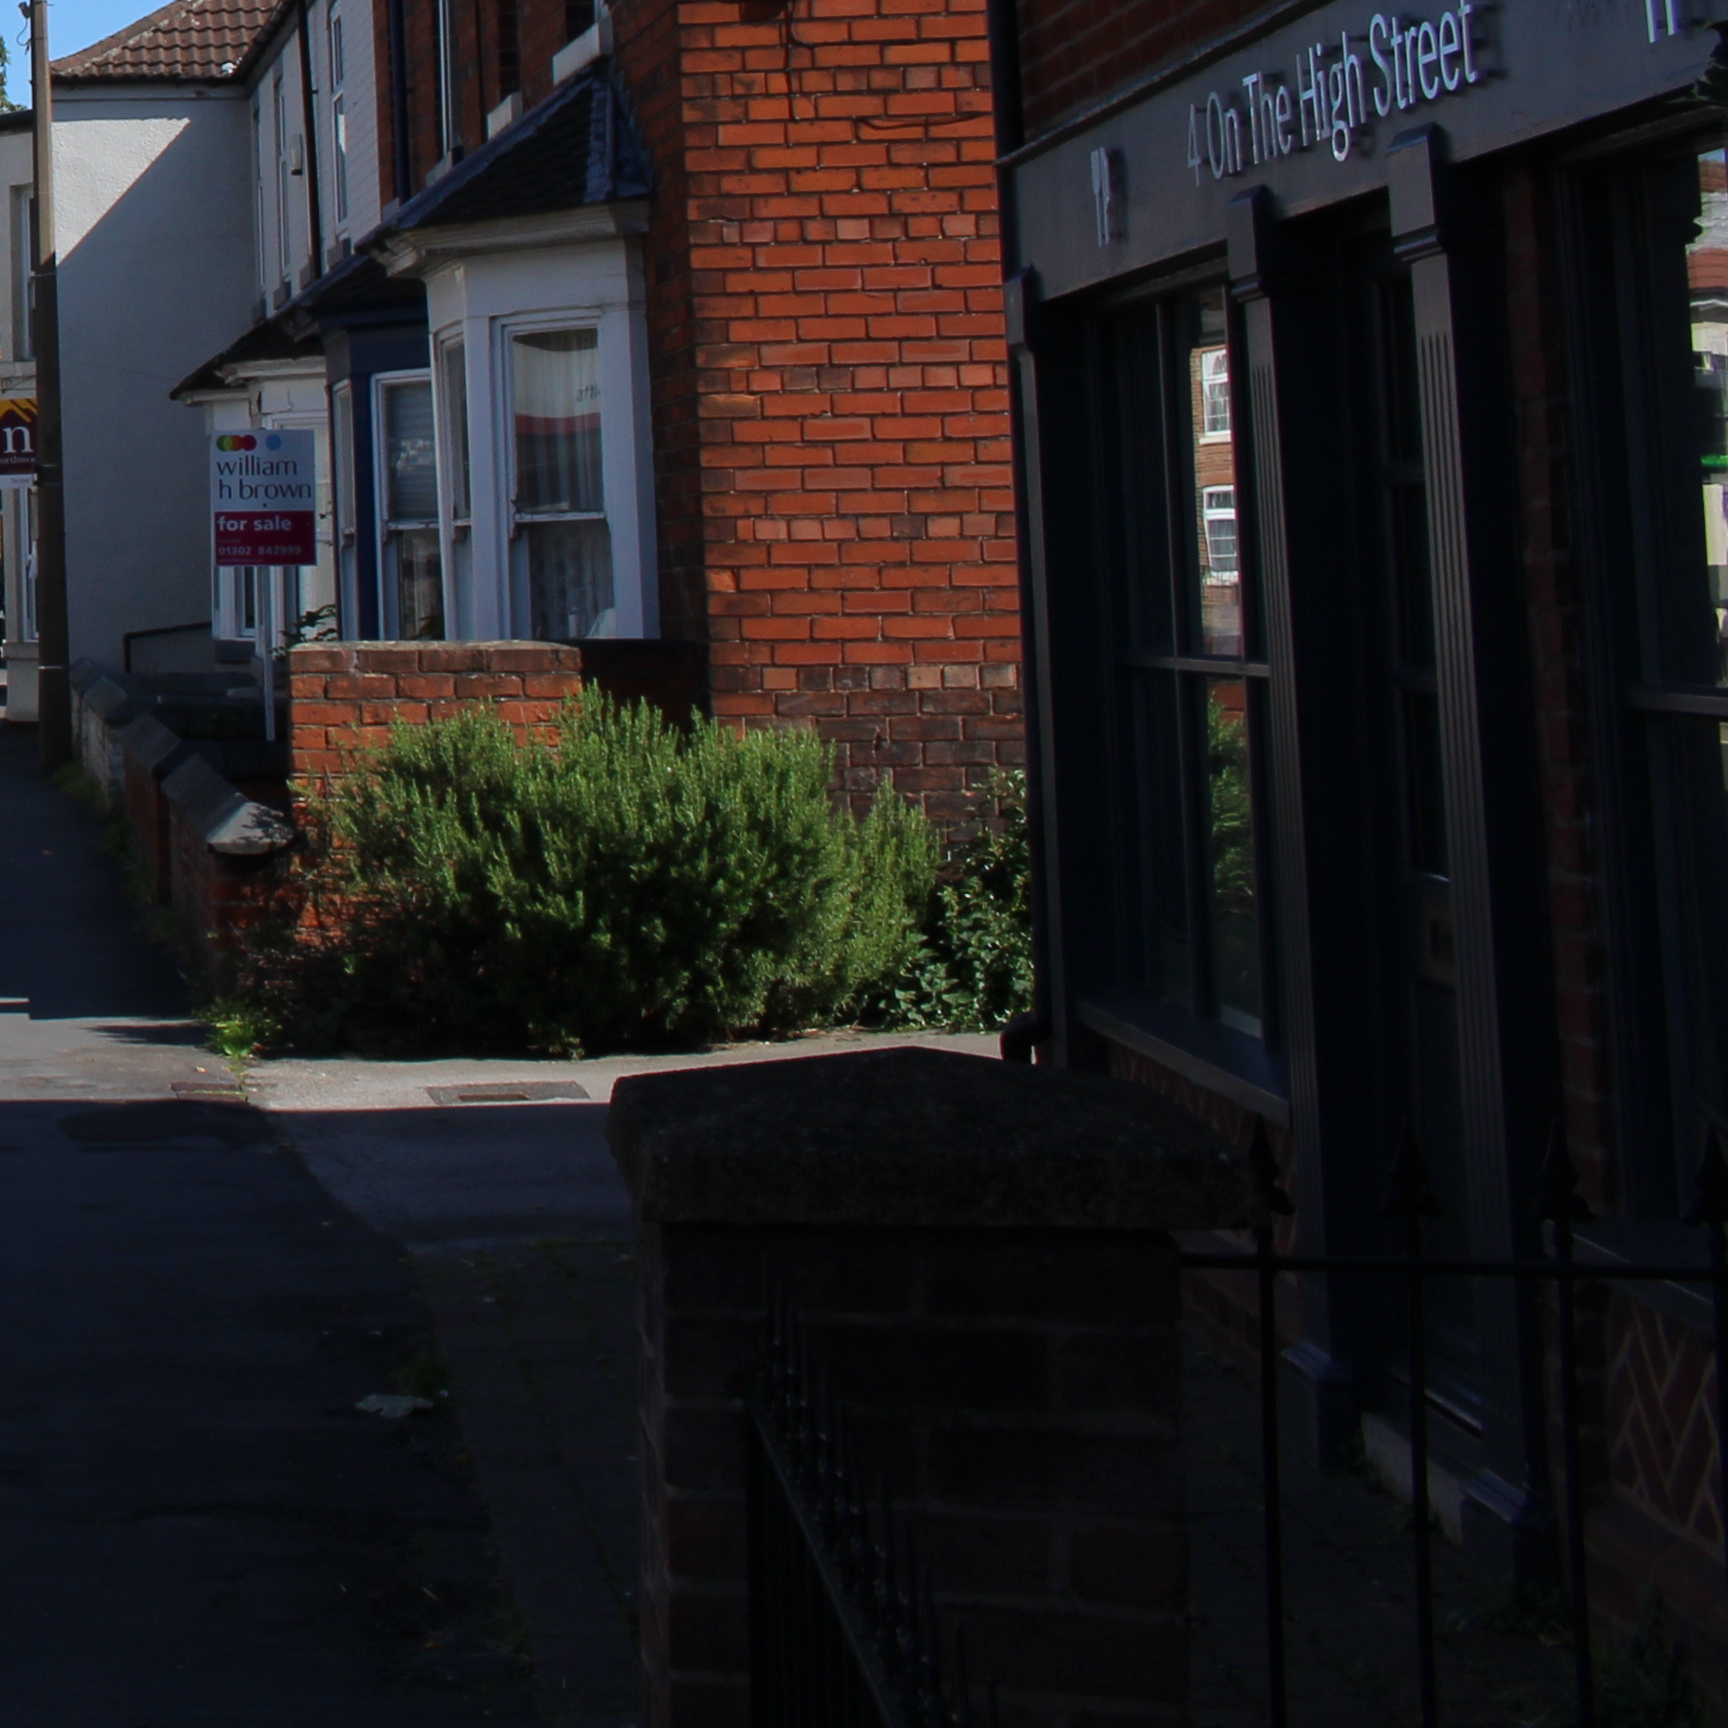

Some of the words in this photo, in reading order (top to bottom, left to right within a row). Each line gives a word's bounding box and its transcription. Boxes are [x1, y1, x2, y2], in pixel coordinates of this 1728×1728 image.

[1188, 104, 1201, 187] 4
[1206, 92, 1243, 179] On
[1242, 71, 1292, 165] The
[1296, 31, 1367, 162] High
[216, 455, 297, 476] william
[218, 479, 232, 499] h
[239, 479, 312, 500] brown
[217, 516, 247, 532] for
[254, 516, 292, 532] sale
[218, 547, 252, 556] 01302
